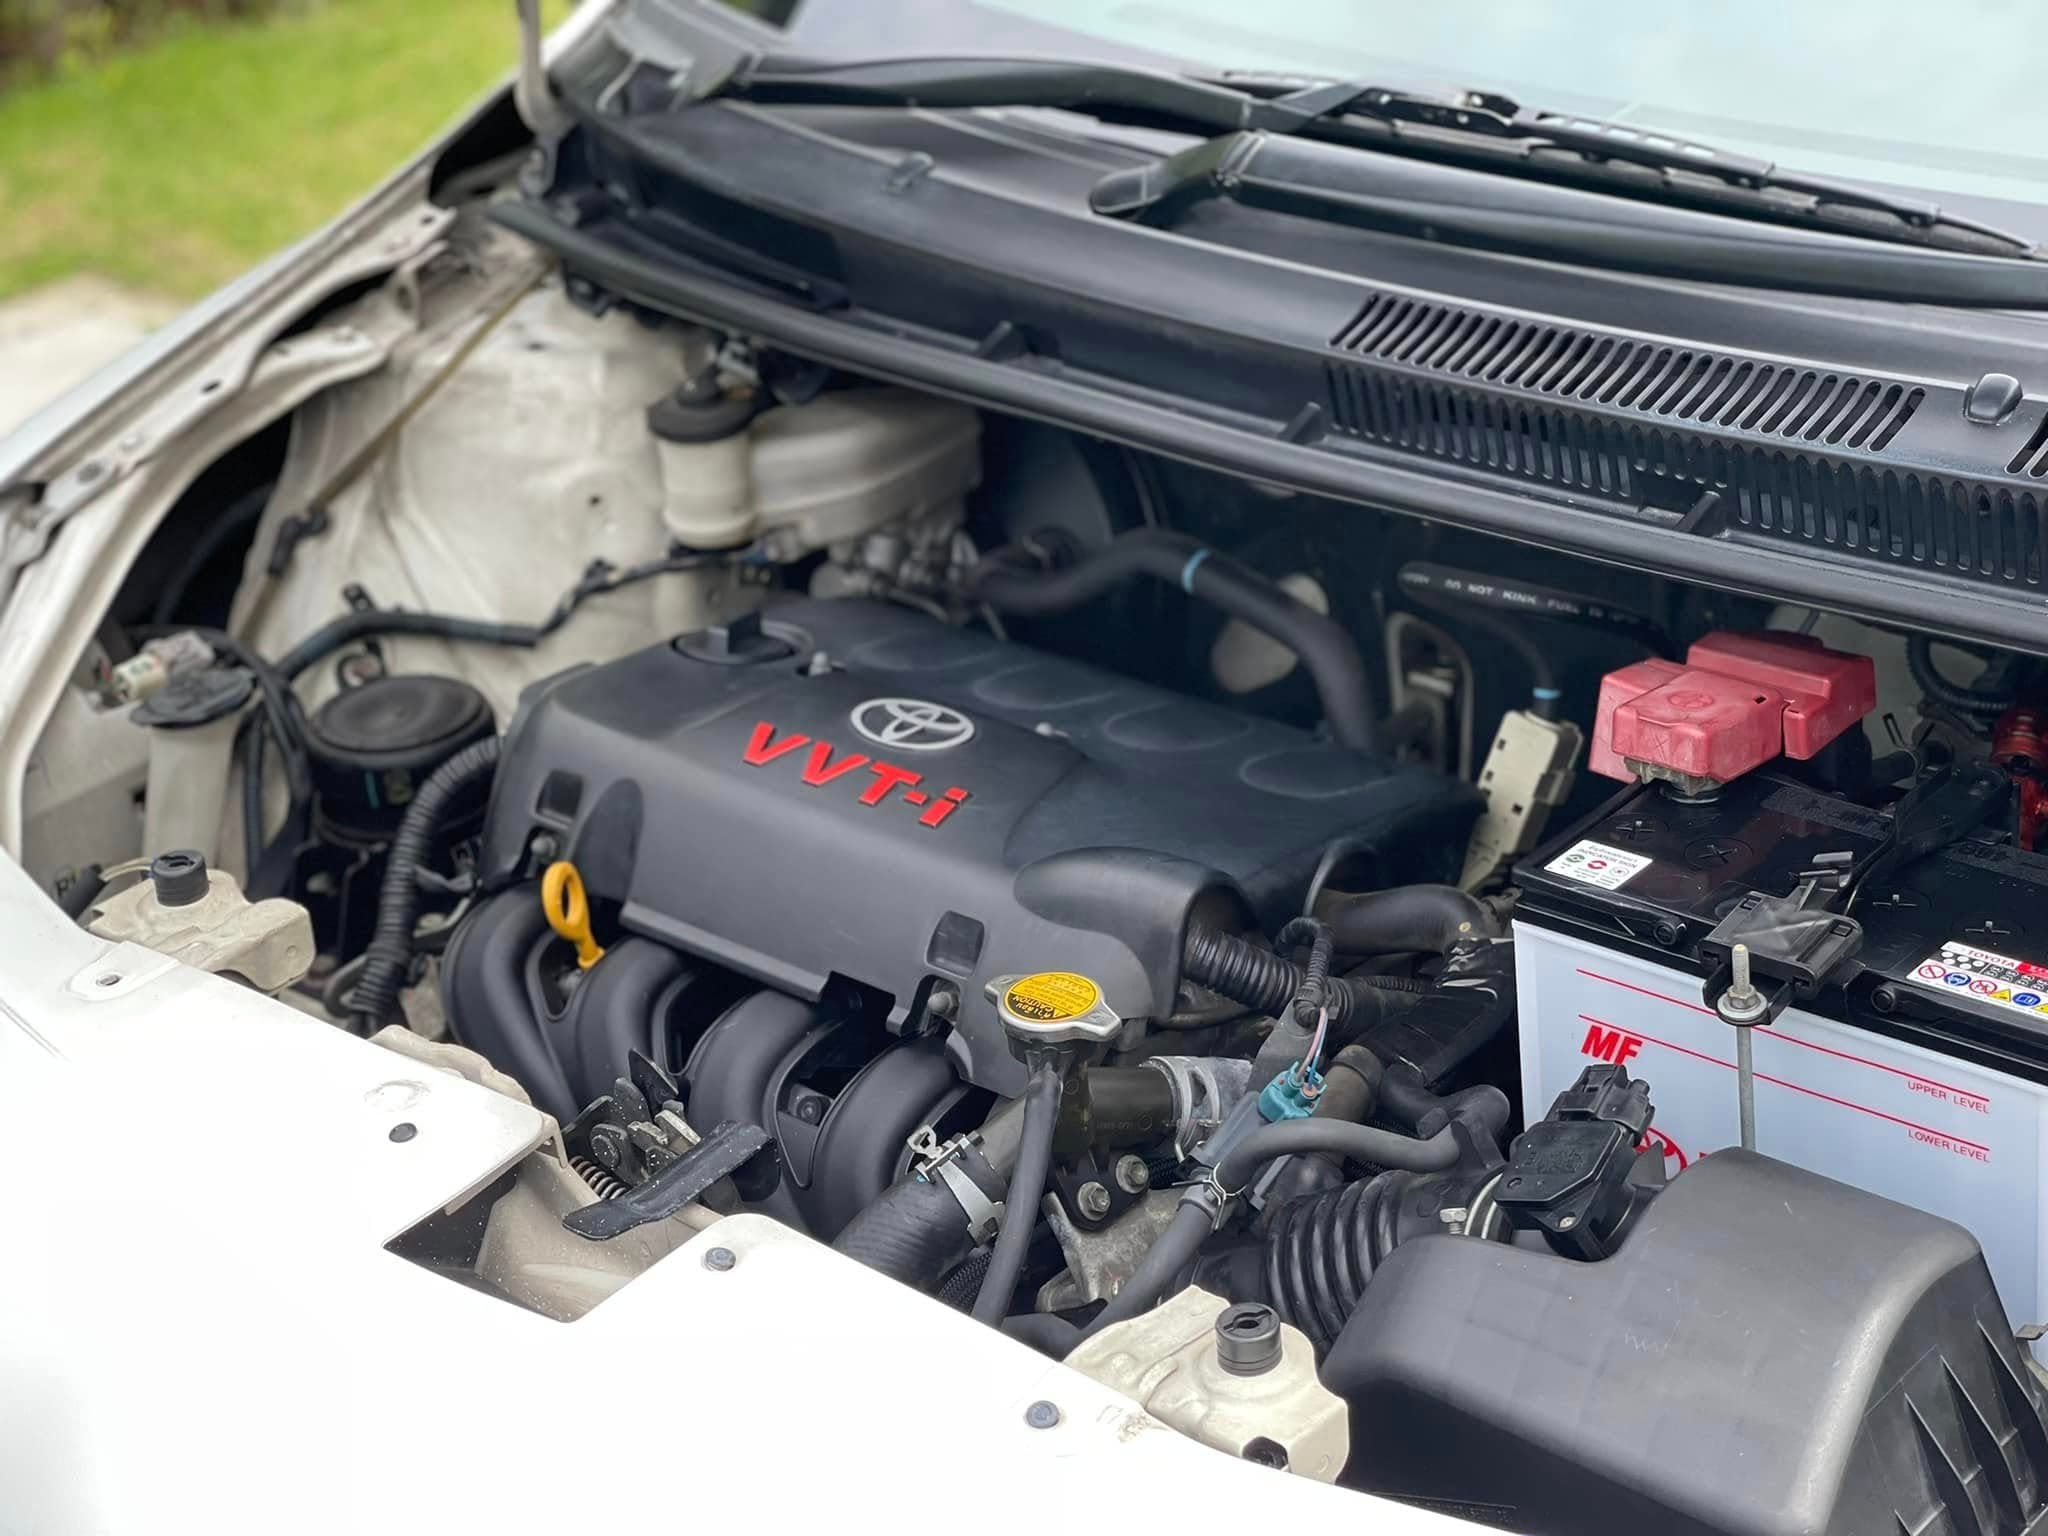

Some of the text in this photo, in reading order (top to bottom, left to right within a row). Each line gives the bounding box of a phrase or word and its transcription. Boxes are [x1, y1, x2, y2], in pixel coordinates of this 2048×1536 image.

[1467, 583, 1495, 596] NOT
[1502, 589, 1537, 605] KINK
[743, 721, 969, 828] VVT-i
[1968, 950, 2015, 968] TOYOTA
[1012, 995, 1054, 1012] CAUTION
[1581, 1025, 1643, 1066] MF
[1907, 1080, 1990, 1114] UPPER LEVEL
[1908, 1129, 1990, 1163] LOWER LEVEL
